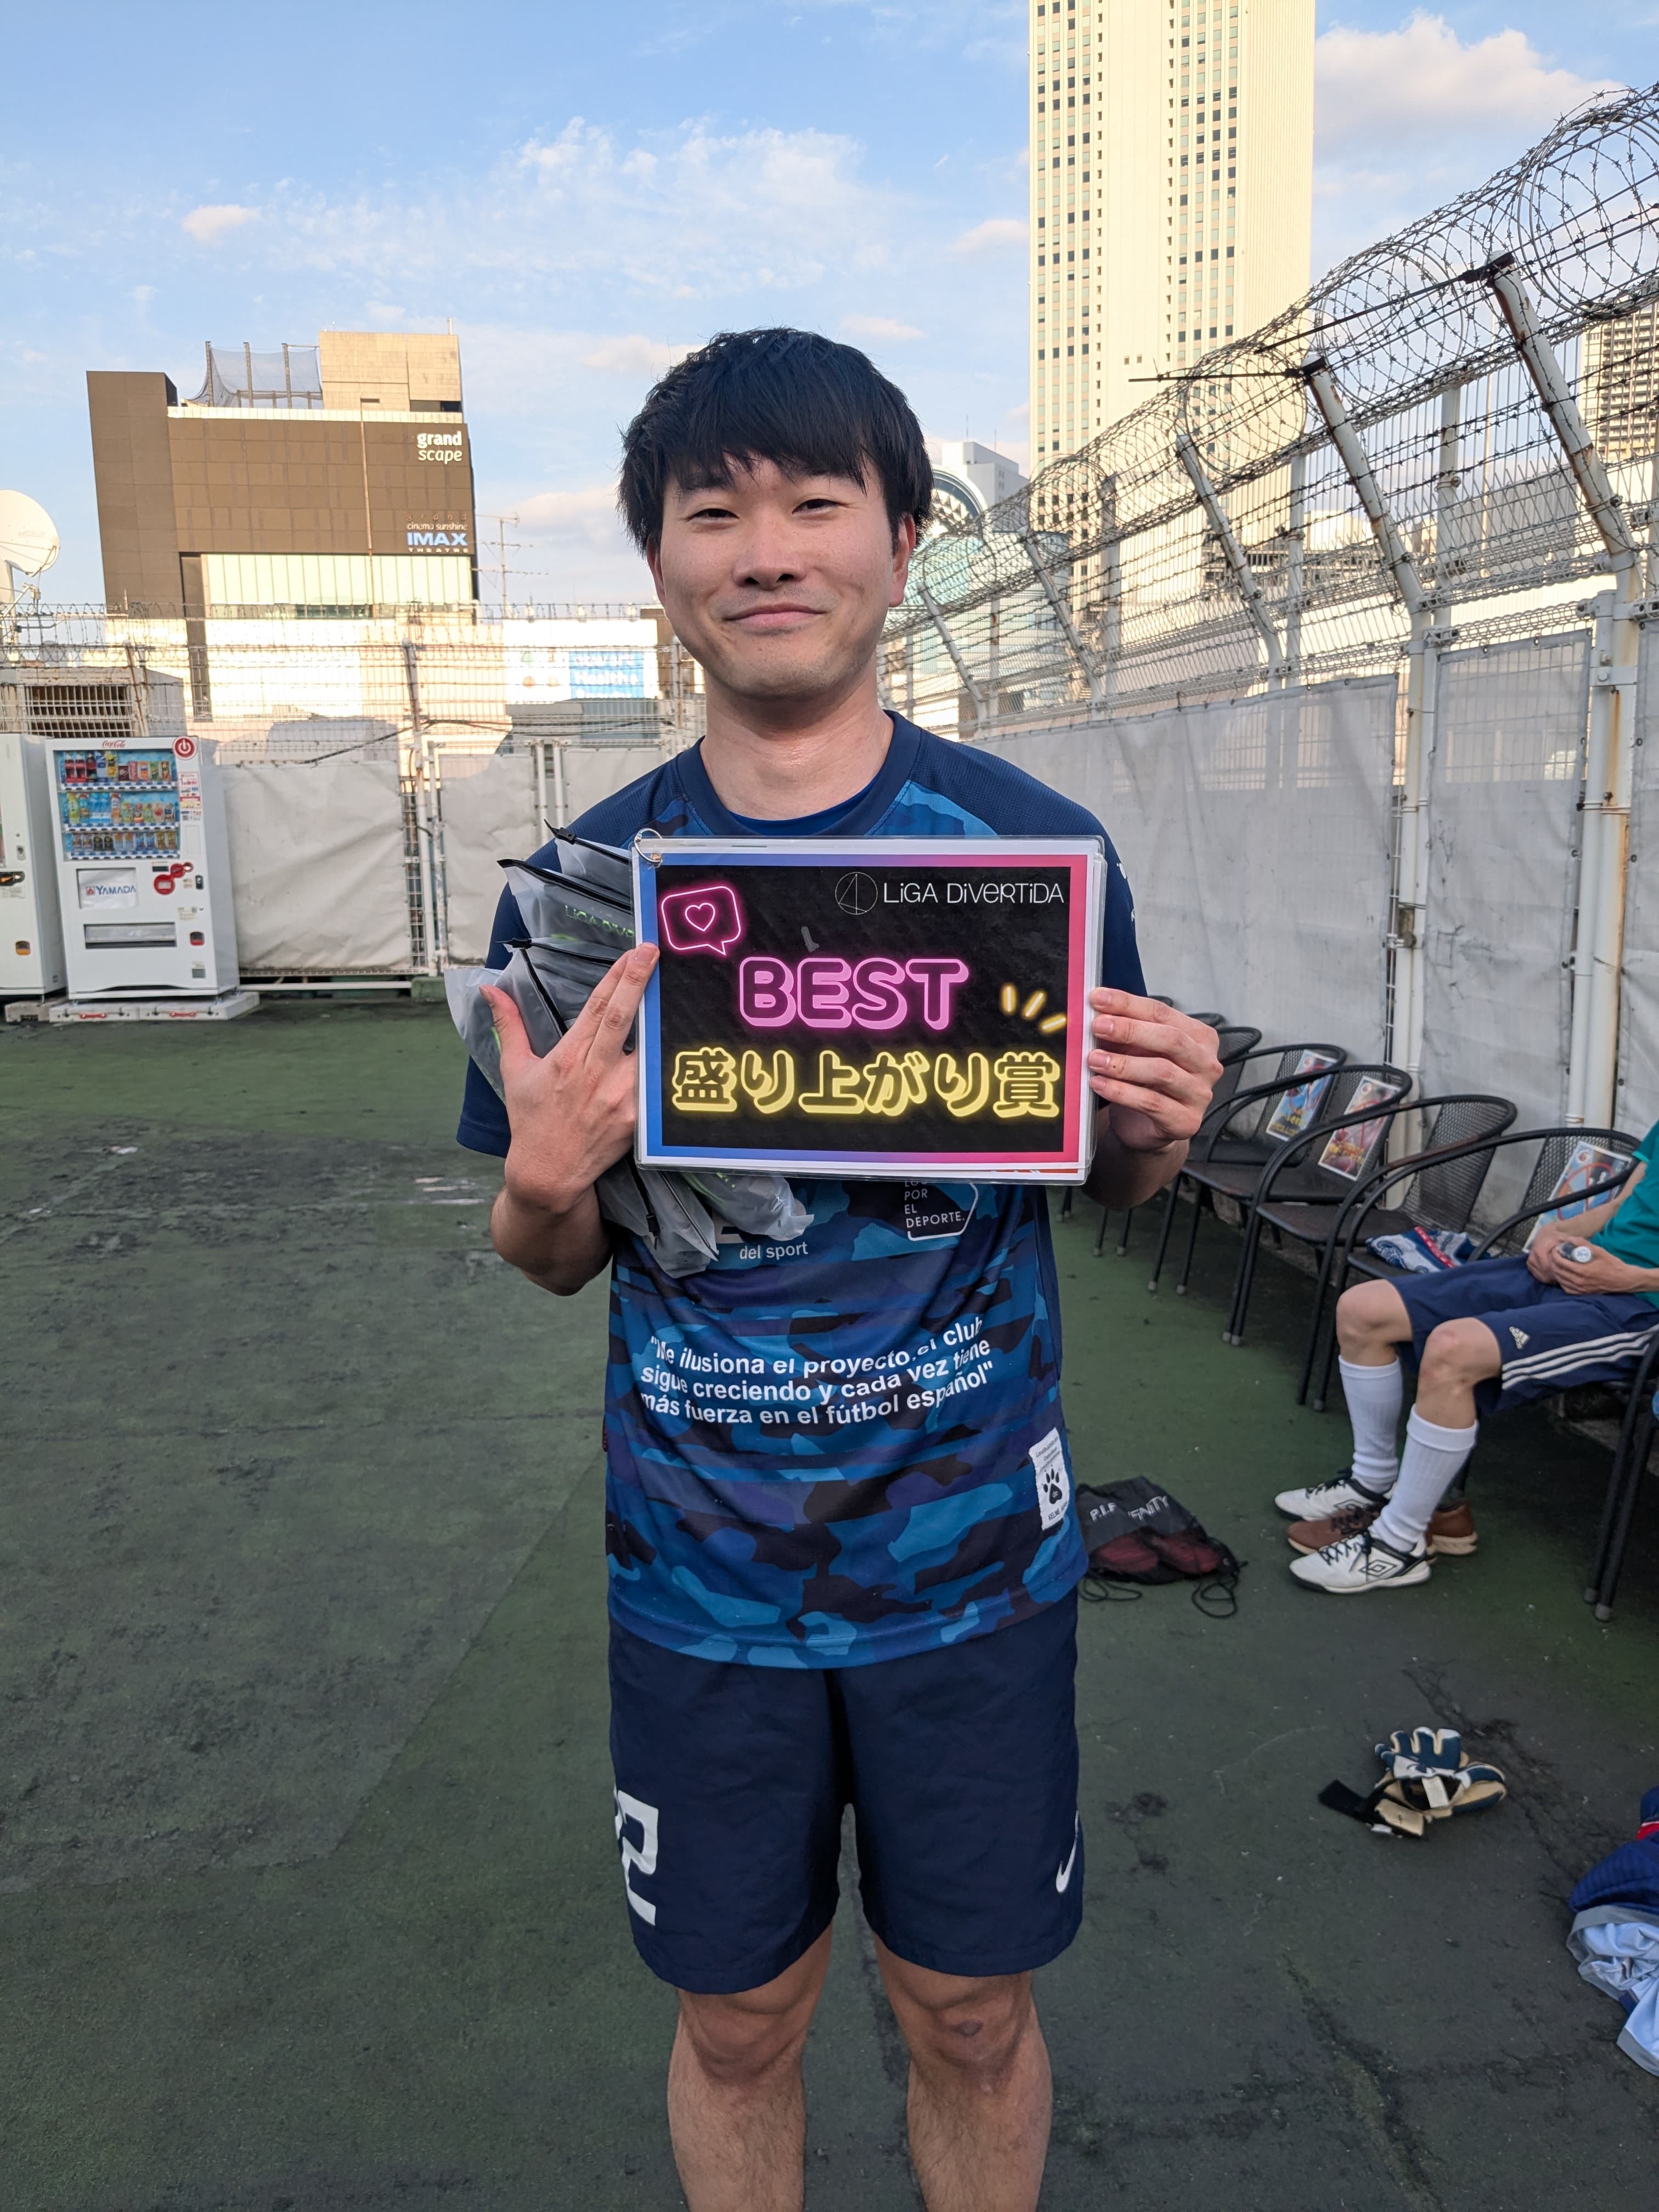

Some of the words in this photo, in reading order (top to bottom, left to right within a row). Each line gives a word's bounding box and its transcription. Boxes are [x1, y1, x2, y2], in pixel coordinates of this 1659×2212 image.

[417, 431, 462, 449] grand
[418, 449, 462, 465] scape
[407, 522, 434, 531] cinema
[435, 522, 468, 531] sunshine
[407, 532, 468, 546] IMAX
[96, 885, 137, 895] YAMADA
[738, 956, 969, 1031] BEST
[671, 1046, 1061, 1119] 盛り上がり賞
[904, 1188, 928, 1201] POR
[904, 1204, 917, 1215] EL
[906, 1211, 965, 1228] DEPORTE.
[740, 1244, 761, 1260] del
[766, 1242, 809, 1260] sport
[679, 1347, 765, 1374] ilusiona
[772, 1357, 795, 1374] el
[917, 1338, 938, 1356] el
[943, 1316, 983, 1346] club
[640, 1364, 689, 1393] sigue
[693, 1380, 811, 1402] creciendo
[818, 1384, 833, 1406] y
[840, 1373, 902, 1398] cada
[906, 1359, 950, 1383] vez
[953, 1339, 991, 1370] tiene
[640, 1392, 680, 1416] más
[685, 1399, 753, 1424] fuerza
[759, 1409, 790, 1425] en
[797, 1406, 819, 1425] el
[826, 1393, 899, 1425] fútbol
[613, 1781, 659, 1927] 2
